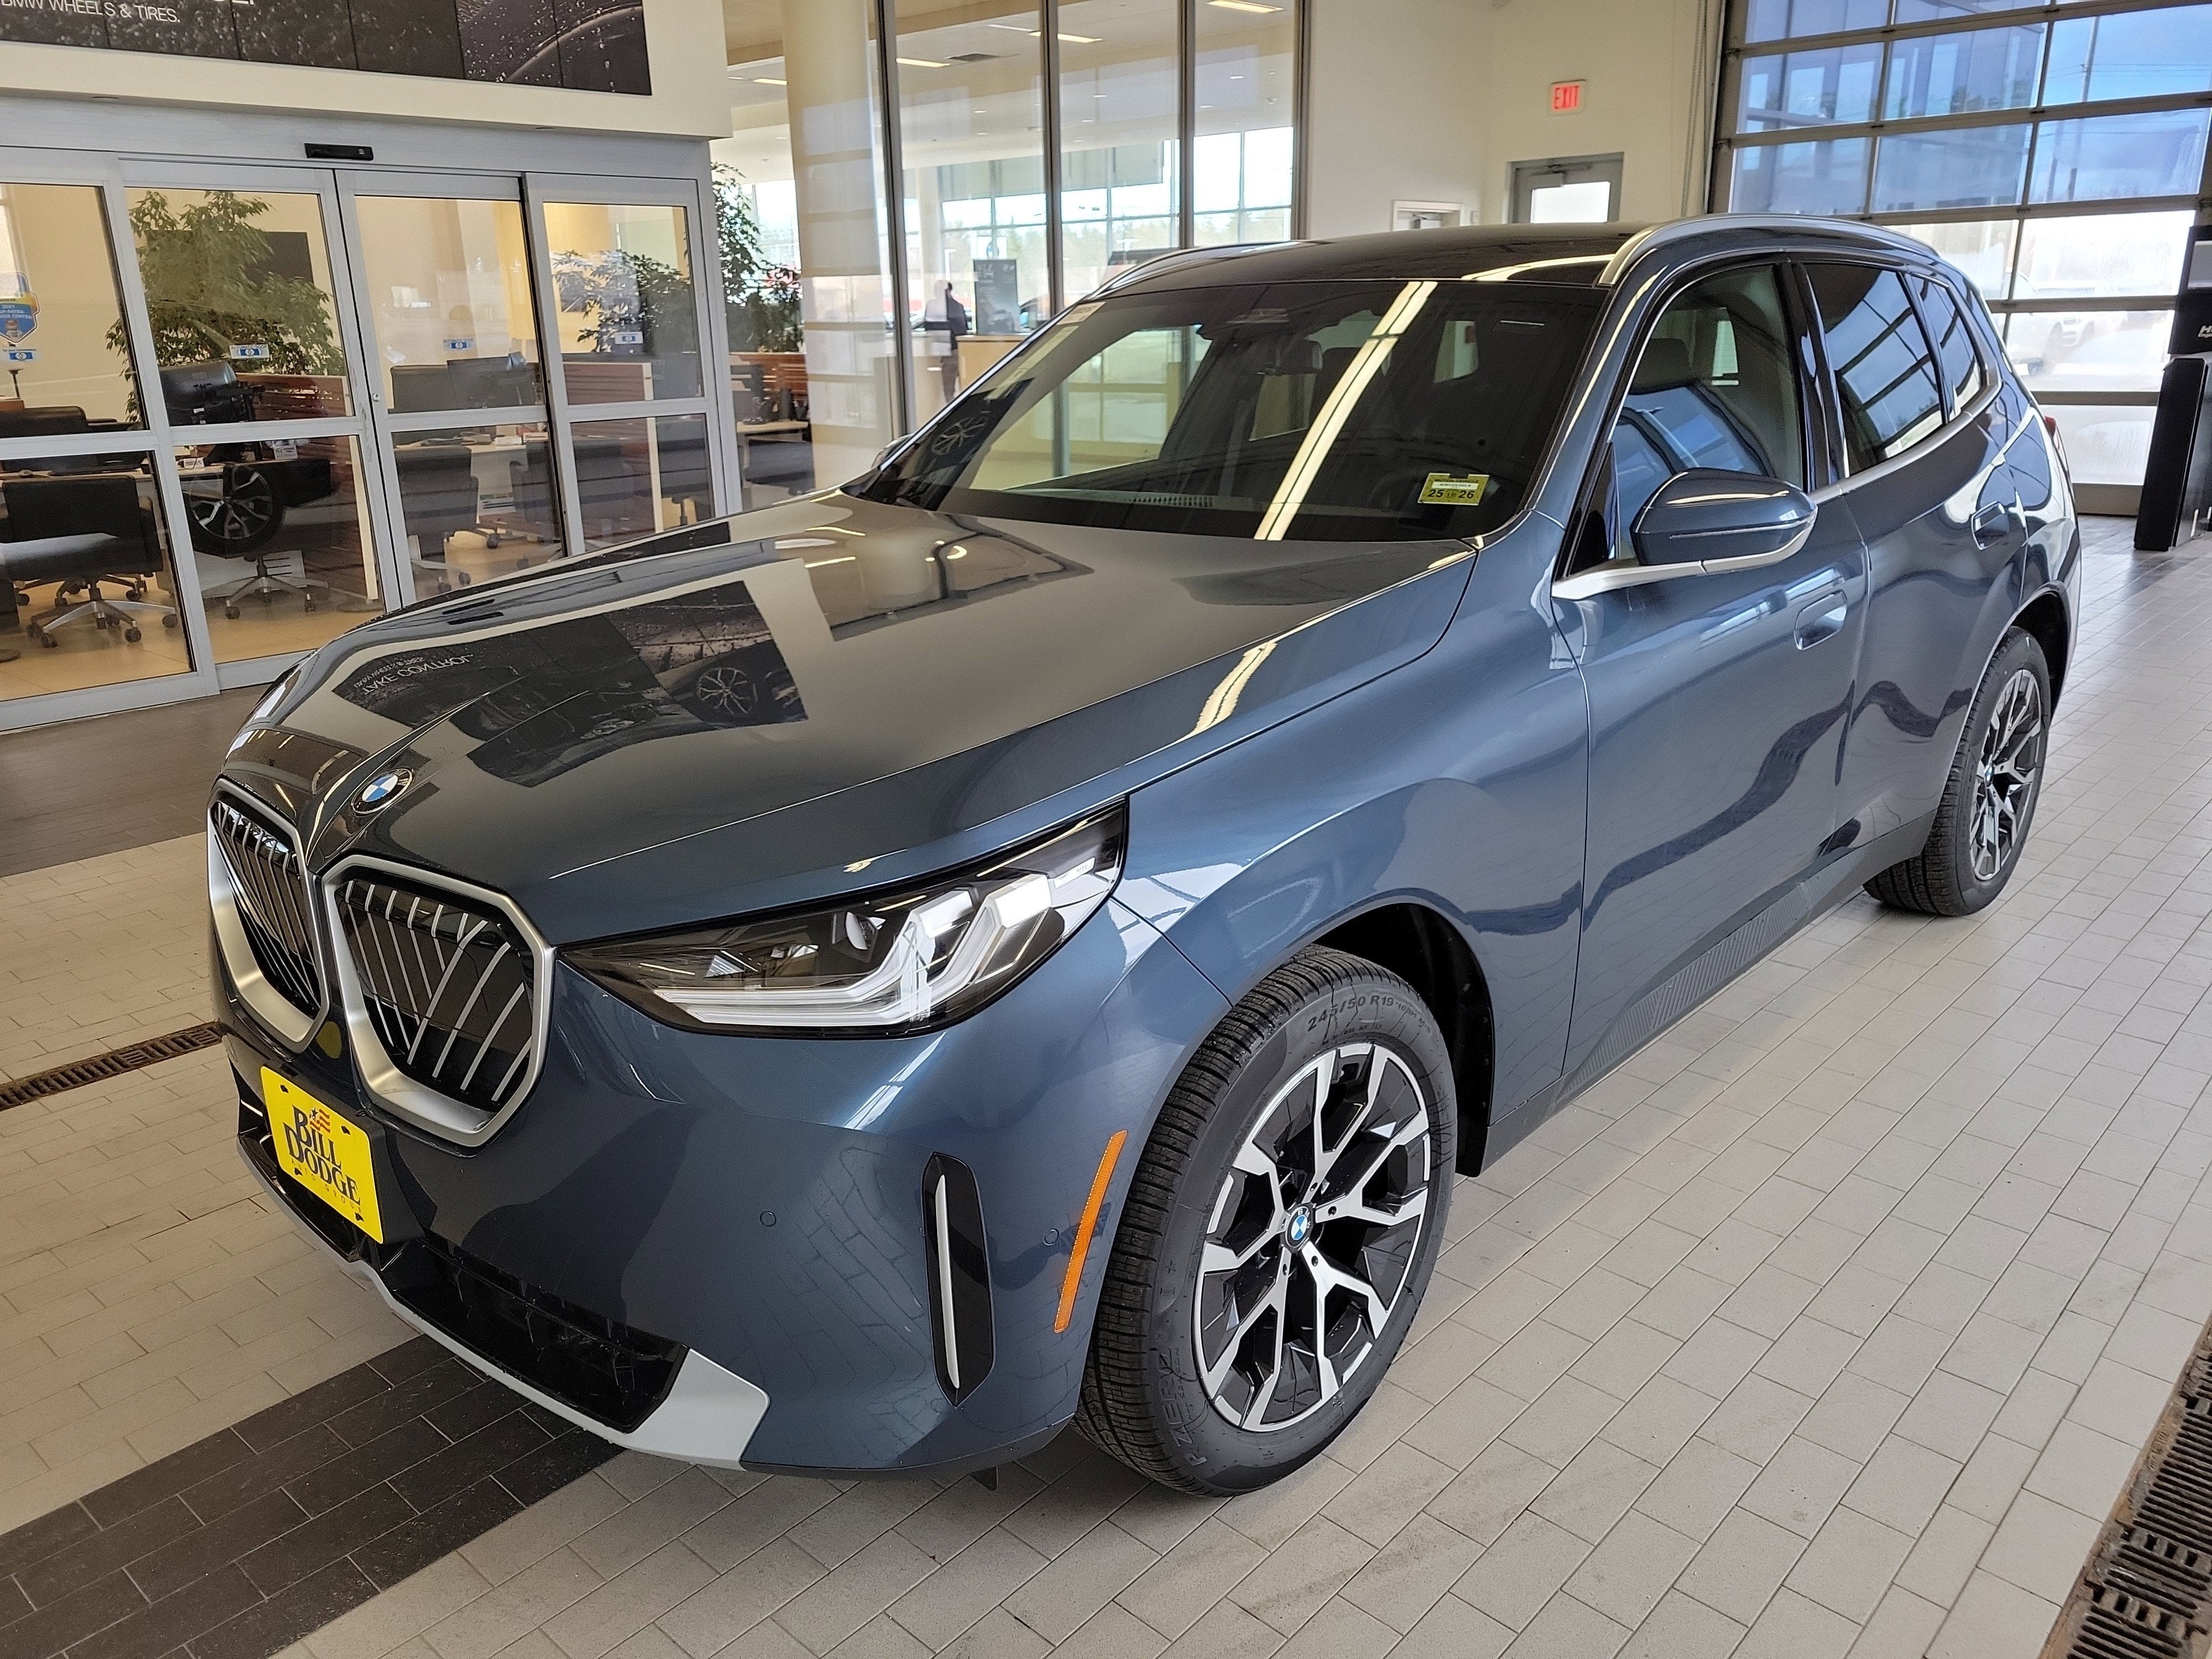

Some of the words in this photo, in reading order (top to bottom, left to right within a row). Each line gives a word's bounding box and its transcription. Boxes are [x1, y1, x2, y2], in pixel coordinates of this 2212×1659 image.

[49, 0, 116, 16] WHEELS
[120, 3, 132, 18] &
[133, 5, 180, 23] TIRES.
[1554, 85, 1579, 109] EXIT
[1428, 489, 1444, 498] 25
[1458, 490, 1475, 499] 26
[292, 1104, 342, 1171] BILL
[283, 1121, 361, 1206] DODGE
[291, 1158, 315, 1181] AUTO
